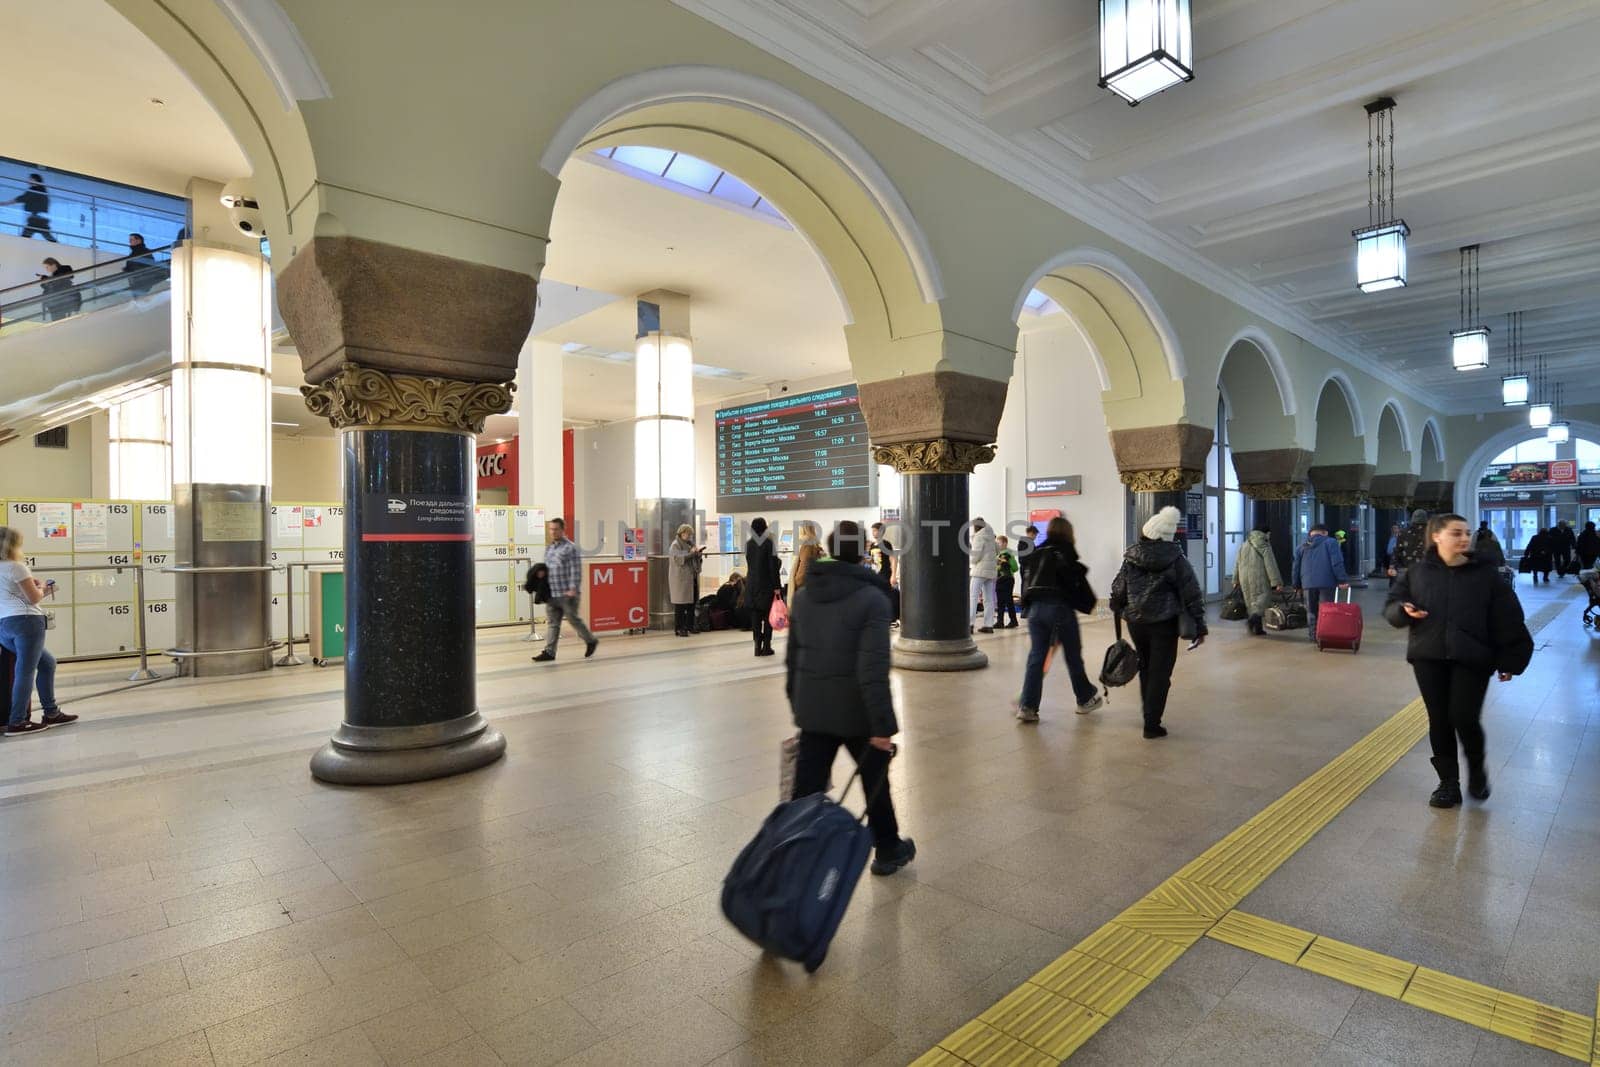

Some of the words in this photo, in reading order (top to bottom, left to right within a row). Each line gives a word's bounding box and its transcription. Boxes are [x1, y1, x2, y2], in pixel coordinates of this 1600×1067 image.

[477, 454, 505, 477] KFC
[410, 498, 437, 507] Поезда
[13, 504, 36, 513] 160
[108, 505, 128, 514] 163
[147, 506, 167, 514] 166
[328, 507, 344, 516] 175
[107, 555, 128, 564] 164
[147, 555, 167, 564] 167
[109, 605, 129, 615] 165
[148, 603, 168, 613] 168
